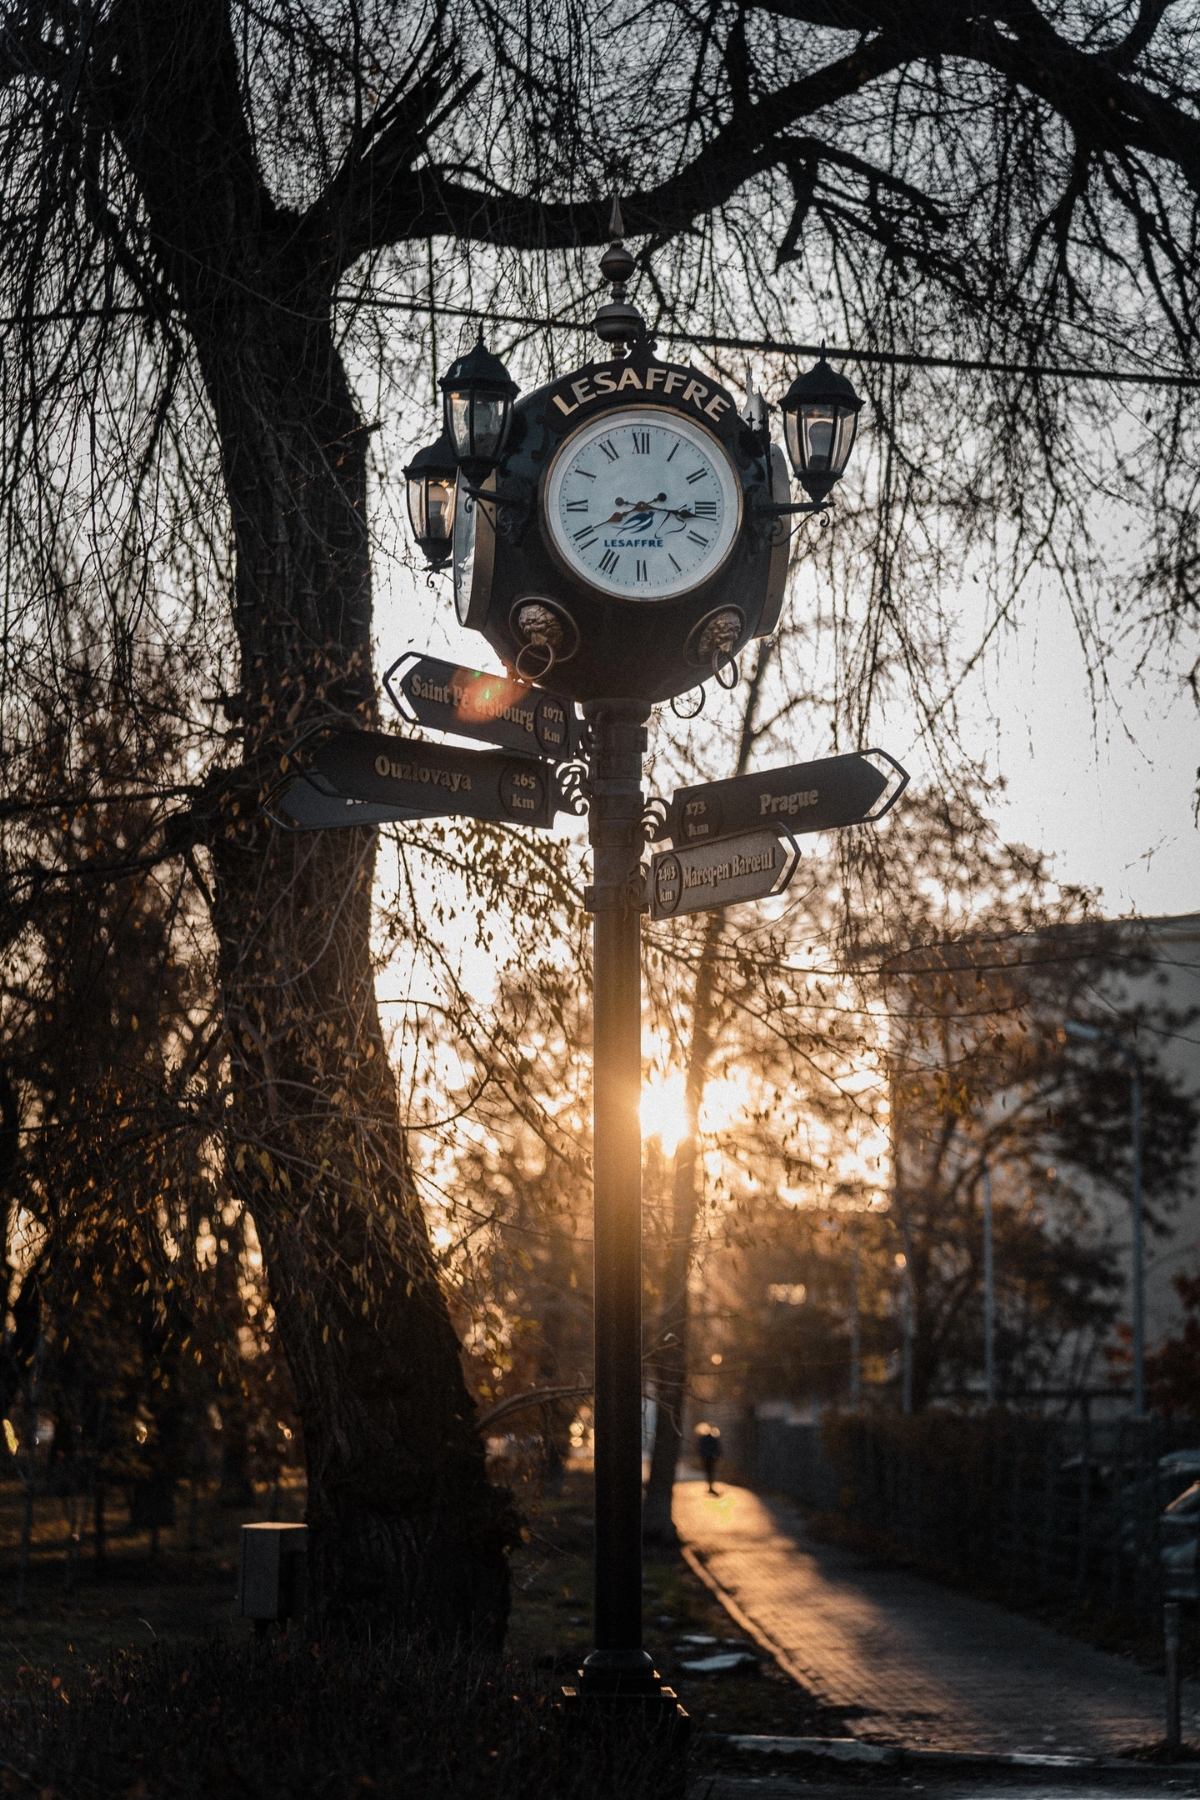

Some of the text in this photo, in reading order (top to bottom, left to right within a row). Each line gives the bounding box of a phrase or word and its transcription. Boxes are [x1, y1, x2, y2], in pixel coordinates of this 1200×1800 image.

[552, 367, 732, 423] LESAFFRE
[598, 439, 620, 464] XI
[631, 431, 651, 455] XII
[686, 467, 709, 485] II
[694, 501, 717, 515] III
[604, 539, 664, 548] LESAFFRE
[410, 673, 535, 733] Saint Peersbourg
[542, 705, 565, 723] 1071
[544, 727, 562, 744] km
[374, 754, 473, 793] Ouzlovaya
[512, 773, 537, 790] 265
[512, 793, 536, 810] km
[759, 788, 820, 816] Prague
[688, 822, 710, 837] km
